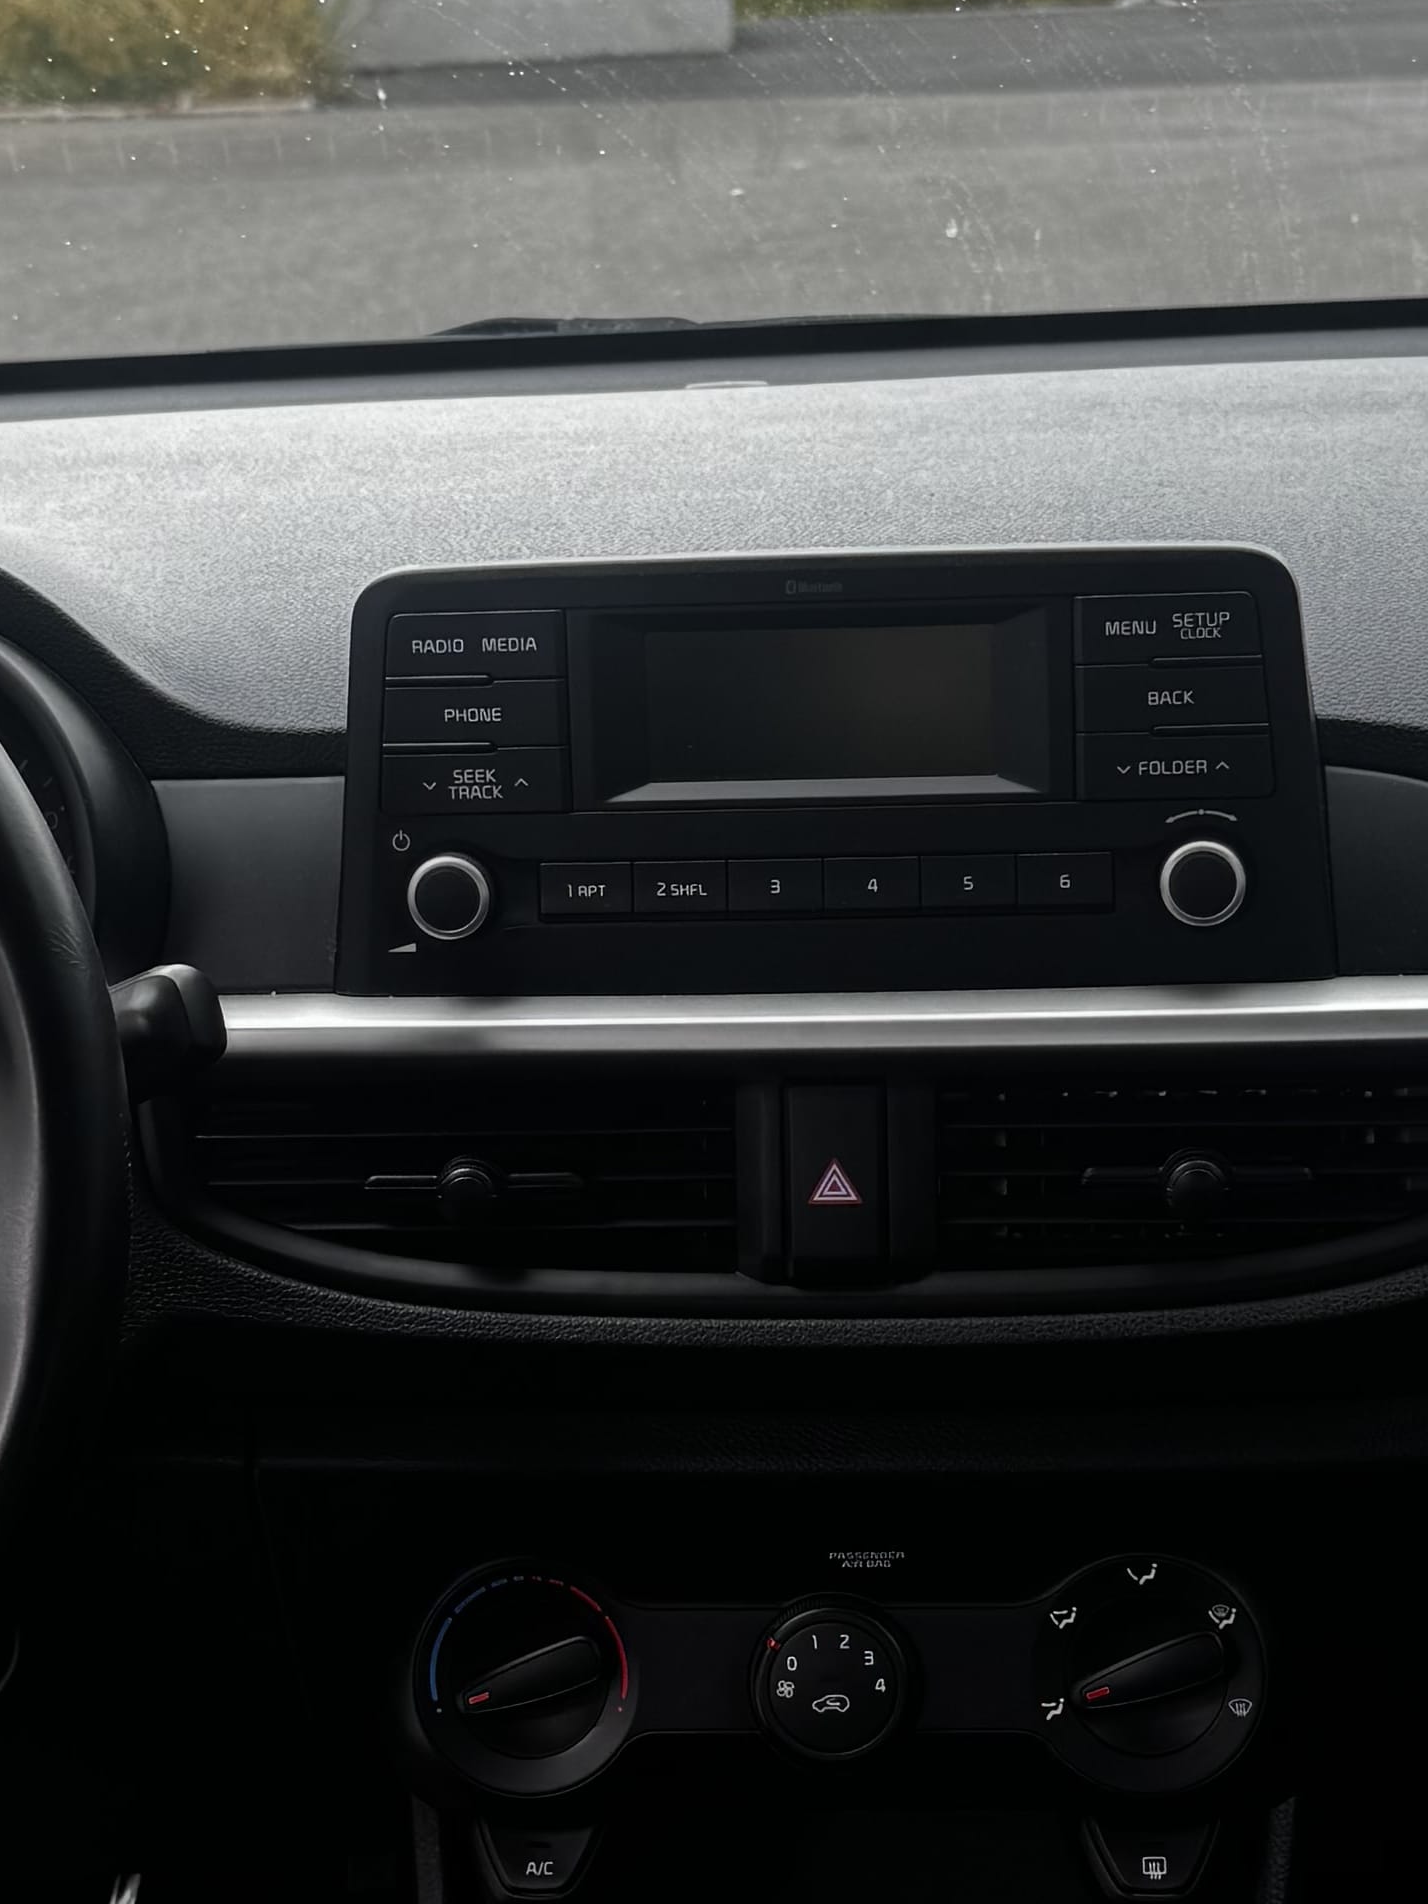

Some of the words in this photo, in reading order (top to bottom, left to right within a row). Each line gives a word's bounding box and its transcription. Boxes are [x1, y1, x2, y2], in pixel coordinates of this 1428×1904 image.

[1172, 611, 1230, 628] SETUP
[1105, 620, 1157, 636] MENU
[1180, 627, 1222, 640] CLOCK
[411, 639, 465, 654] RADIO
[481, 637, 538, 652] MEDIA
[1147, 690, 1195, 705] BACK
[443, 707, 503, 722] PHONE
[1138, 759, 1208, 776] FOLDER
[452, 769, 497, 784] SEEK
[448, 785, 504, 800] TRACK
[770, 879, 781, 894] 3
[867, 878, 878, 893] 4
[963, 876, 974, 891] 5
[1059, 874, 1071, 889] 6
[578, 884, 606, 898] RPT
[656, 882, 666, 897] 2
[670, 883, 708, 897] SHFL
[812, 1634, 819, 1651] 1
[838, 1634, 851, 1650] 2
[786, 1655, 799, 1672] 0
[863, 1650, 875, 1666] 3
[874, 1678, 887, 1694] 4
[525, 1861, 555, 1876] A/C
